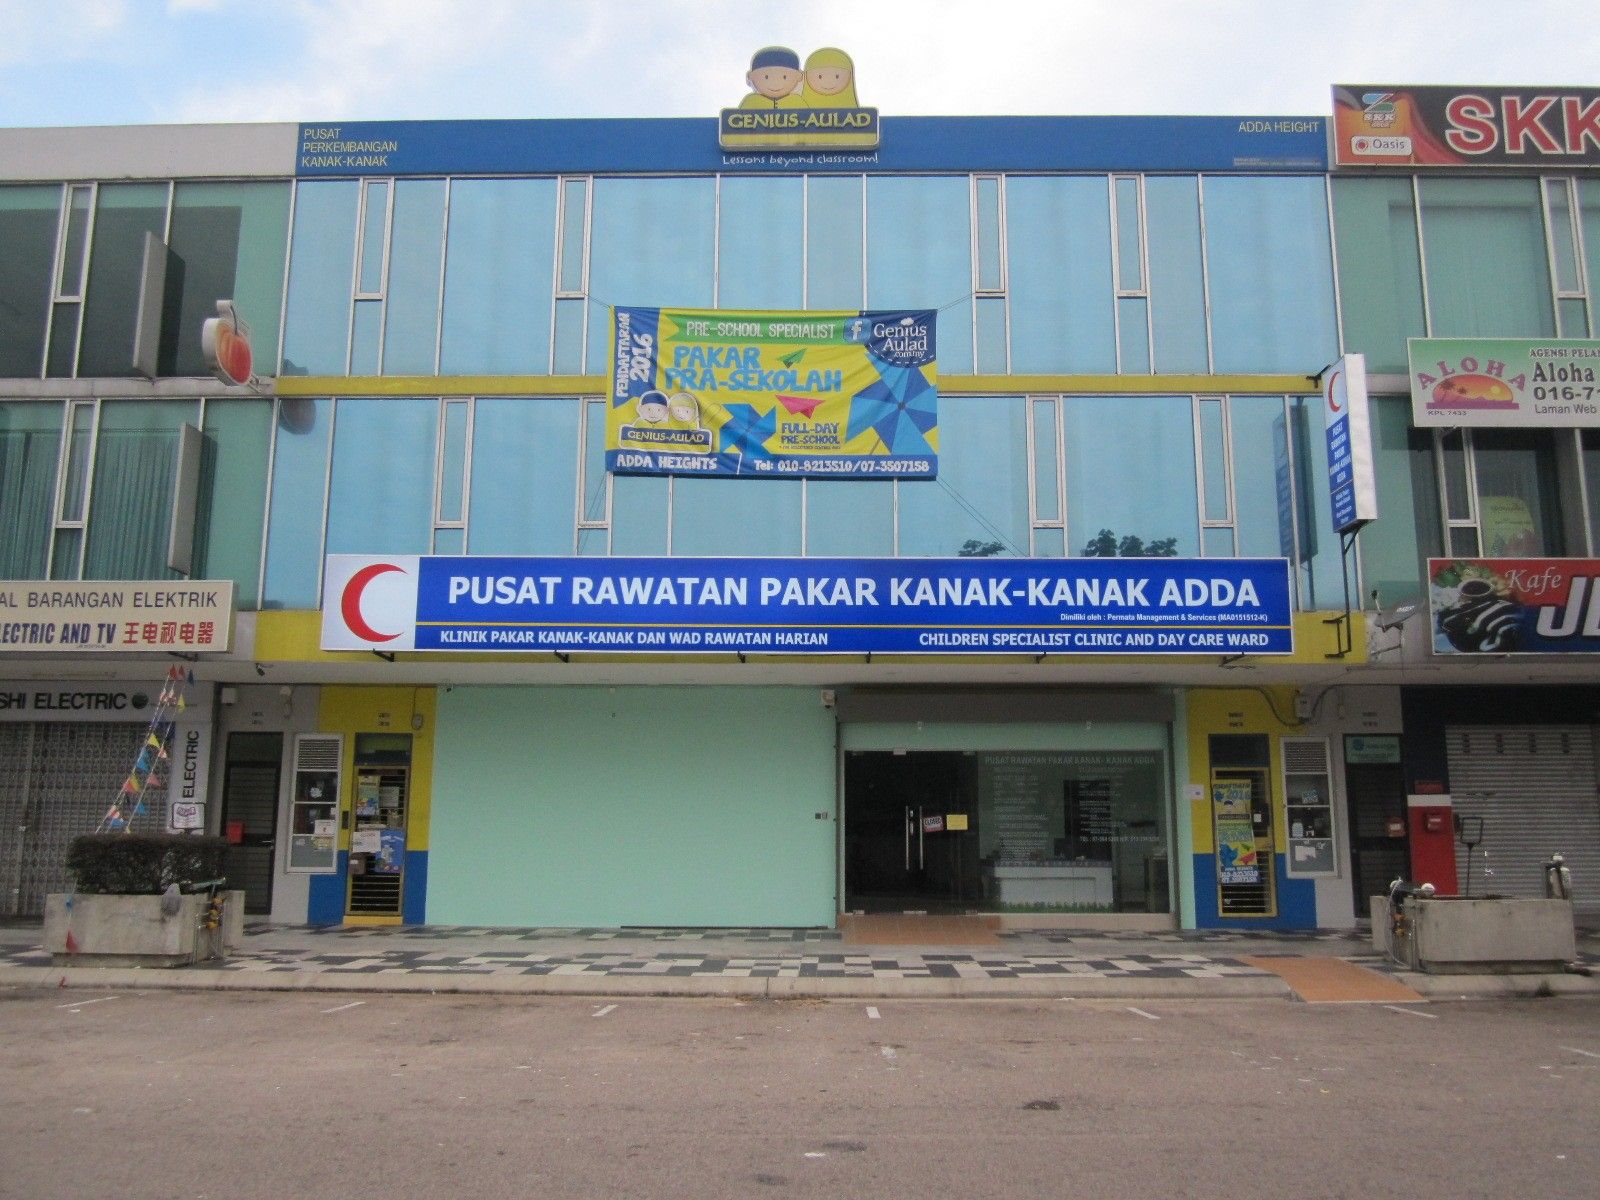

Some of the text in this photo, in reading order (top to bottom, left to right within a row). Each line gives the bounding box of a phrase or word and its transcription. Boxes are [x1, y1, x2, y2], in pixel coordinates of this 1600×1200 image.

[728, 112, 871, 129] GENIUS-AULAD
[1239, 121, 1319, 133] ADDA HEIGHT
[1445, 94, 1600, 155] SKK
[304, 128, 341, 139] PUSAT
[303, 141, 397, 153] PERKEMBANGAN
[1372, 139, 1405, 150] Oasis
[301, 156, 388, 167] KANAK-KANAK
[723, 153, 879, 167] Lessons beyond classroom!
[686, 321, 836, 339] PRE-SCHOOL SPECIALIST
[873, 322, 927, 338] Genius
[883, 337, 928, 351] Aulad
[630, 333, 653, 383] 2016
[673, 345, 762, 369] PAKAR
[1530, 348, 1600, 358] AGENSI PELA
[1417, 356, 1526, 392] ALOHA
[1532, 361, 1595, 382] Aloha
[664, 367, 842, 393] PRA-SEKOLAH
[1535, 403, 1597, 414] Laman Web
[781, 422, 840, 434] FULL-DAY
[627, 430, 705, 443] GENIUS-AULAD
[616, 454, 718, 470] ADDA HEIGHTS
[1504, 566, 1562, 596] Kafe
[449, 575, 1261, 607] PUSAT RAWATAN PAKAR KANAK-KANAK ADDA
[28, 591, 124, 608] BARANGAN
[133, 591, 218, 608] ELEKTRIK
[1060, 613, 1086, 621] Dimiliki
[1087, 613, 1102, 621] oleh
[1107, 613, 1135, 621] Permata
[1136, 613, 1178, 623] Management
[1187, 613, 1217, 621] Services
[0, 622, 117, 644] ECTRIC AND TV
[123, 621, 214, 644] 王电视电器
[440, 630, 828, 645] KLINIK PAKAR KANAK-KANAK DAN WAD RAWATAN HARIAN
[919, 633, 1269, 646] CHILDREN SPECIALIST CLINIC AND DAY CARE WARD
[34, 692, 127, 710] ELECTRIC
[182, 730, 199, 799] ELECTRIC
